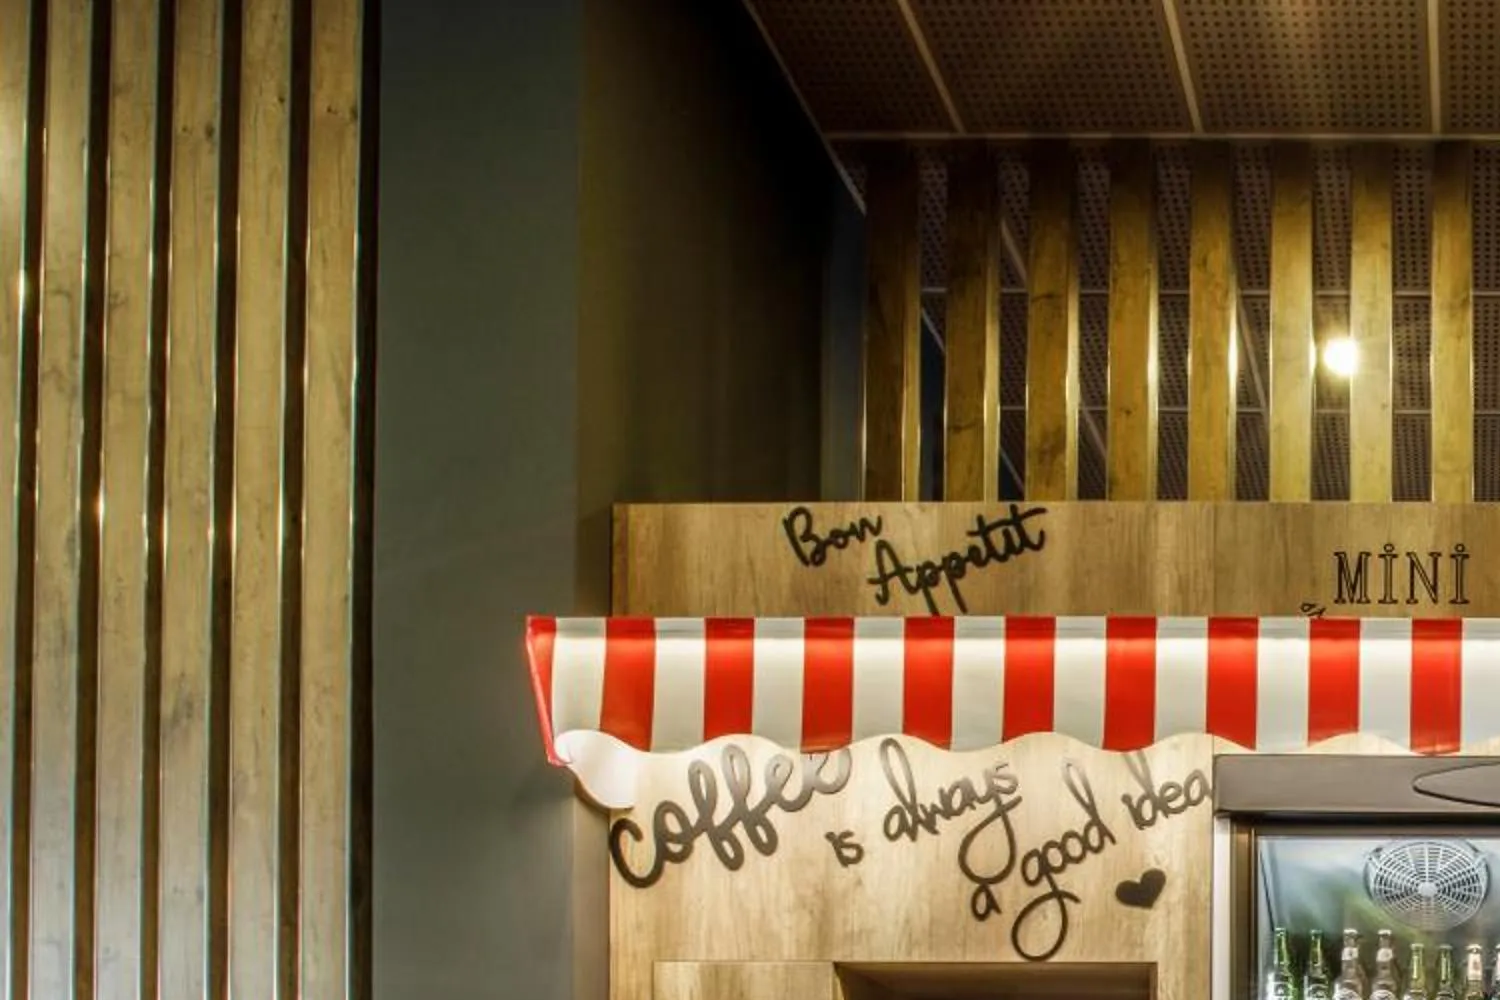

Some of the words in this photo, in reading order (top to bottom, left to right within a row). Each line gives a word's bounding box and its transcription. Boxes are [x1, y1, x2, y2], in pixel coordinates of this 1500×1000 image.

[783, 507, 882, 568] Bon
[867, 504, 1047, 616] Appetit
[608, 744, 852, 889] coffee
[826, 830, 864, 868] is
[879, 737, 1023, 885] always
[971, 883, 1001, 922] a
[1012, 757, 1115, 962] good
[1122, 750, 1214, 831] idea
